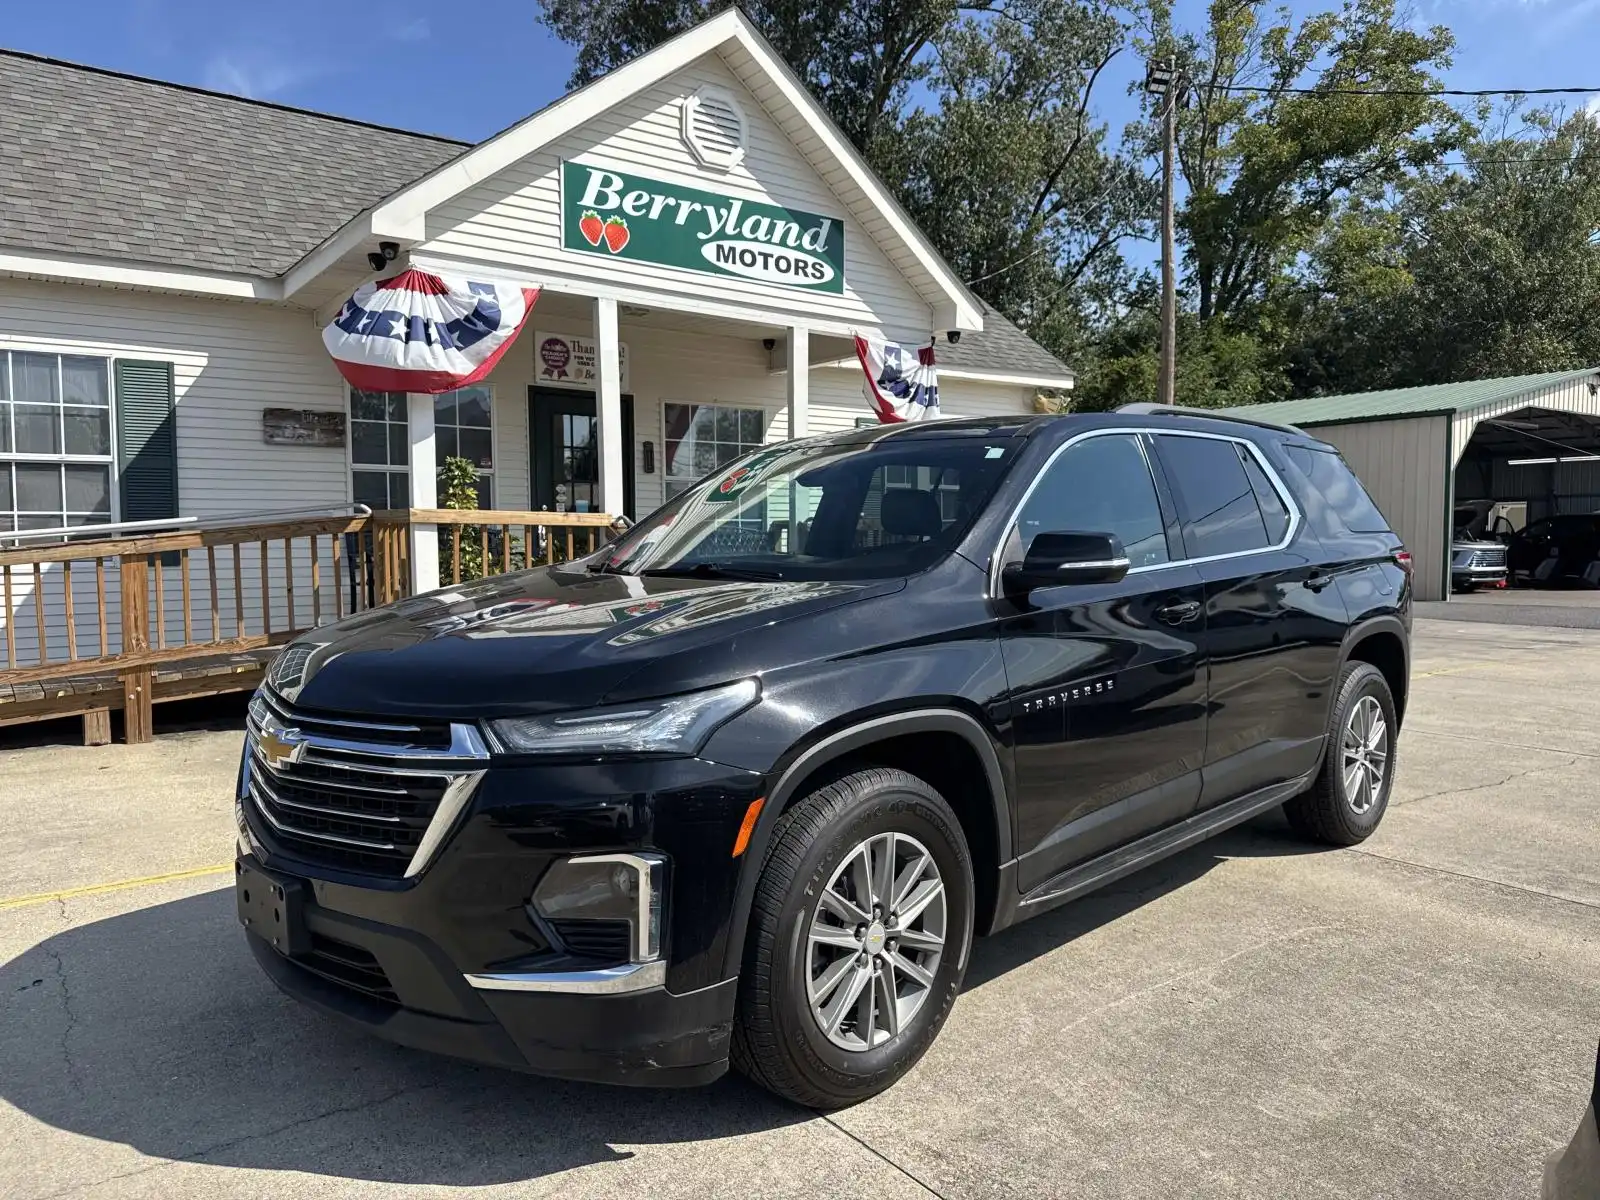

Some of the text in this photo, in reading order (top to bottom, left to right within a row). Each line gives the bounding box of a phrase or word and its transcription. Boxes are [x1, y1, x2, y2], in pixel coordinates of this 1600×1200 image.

[577, 167, 832, 252] Berryland
[715, 243, 826, 281] MOTORS
[569, 340, 595, 355] Than
[1023, 680, 1114, 713] TRAVERSE
